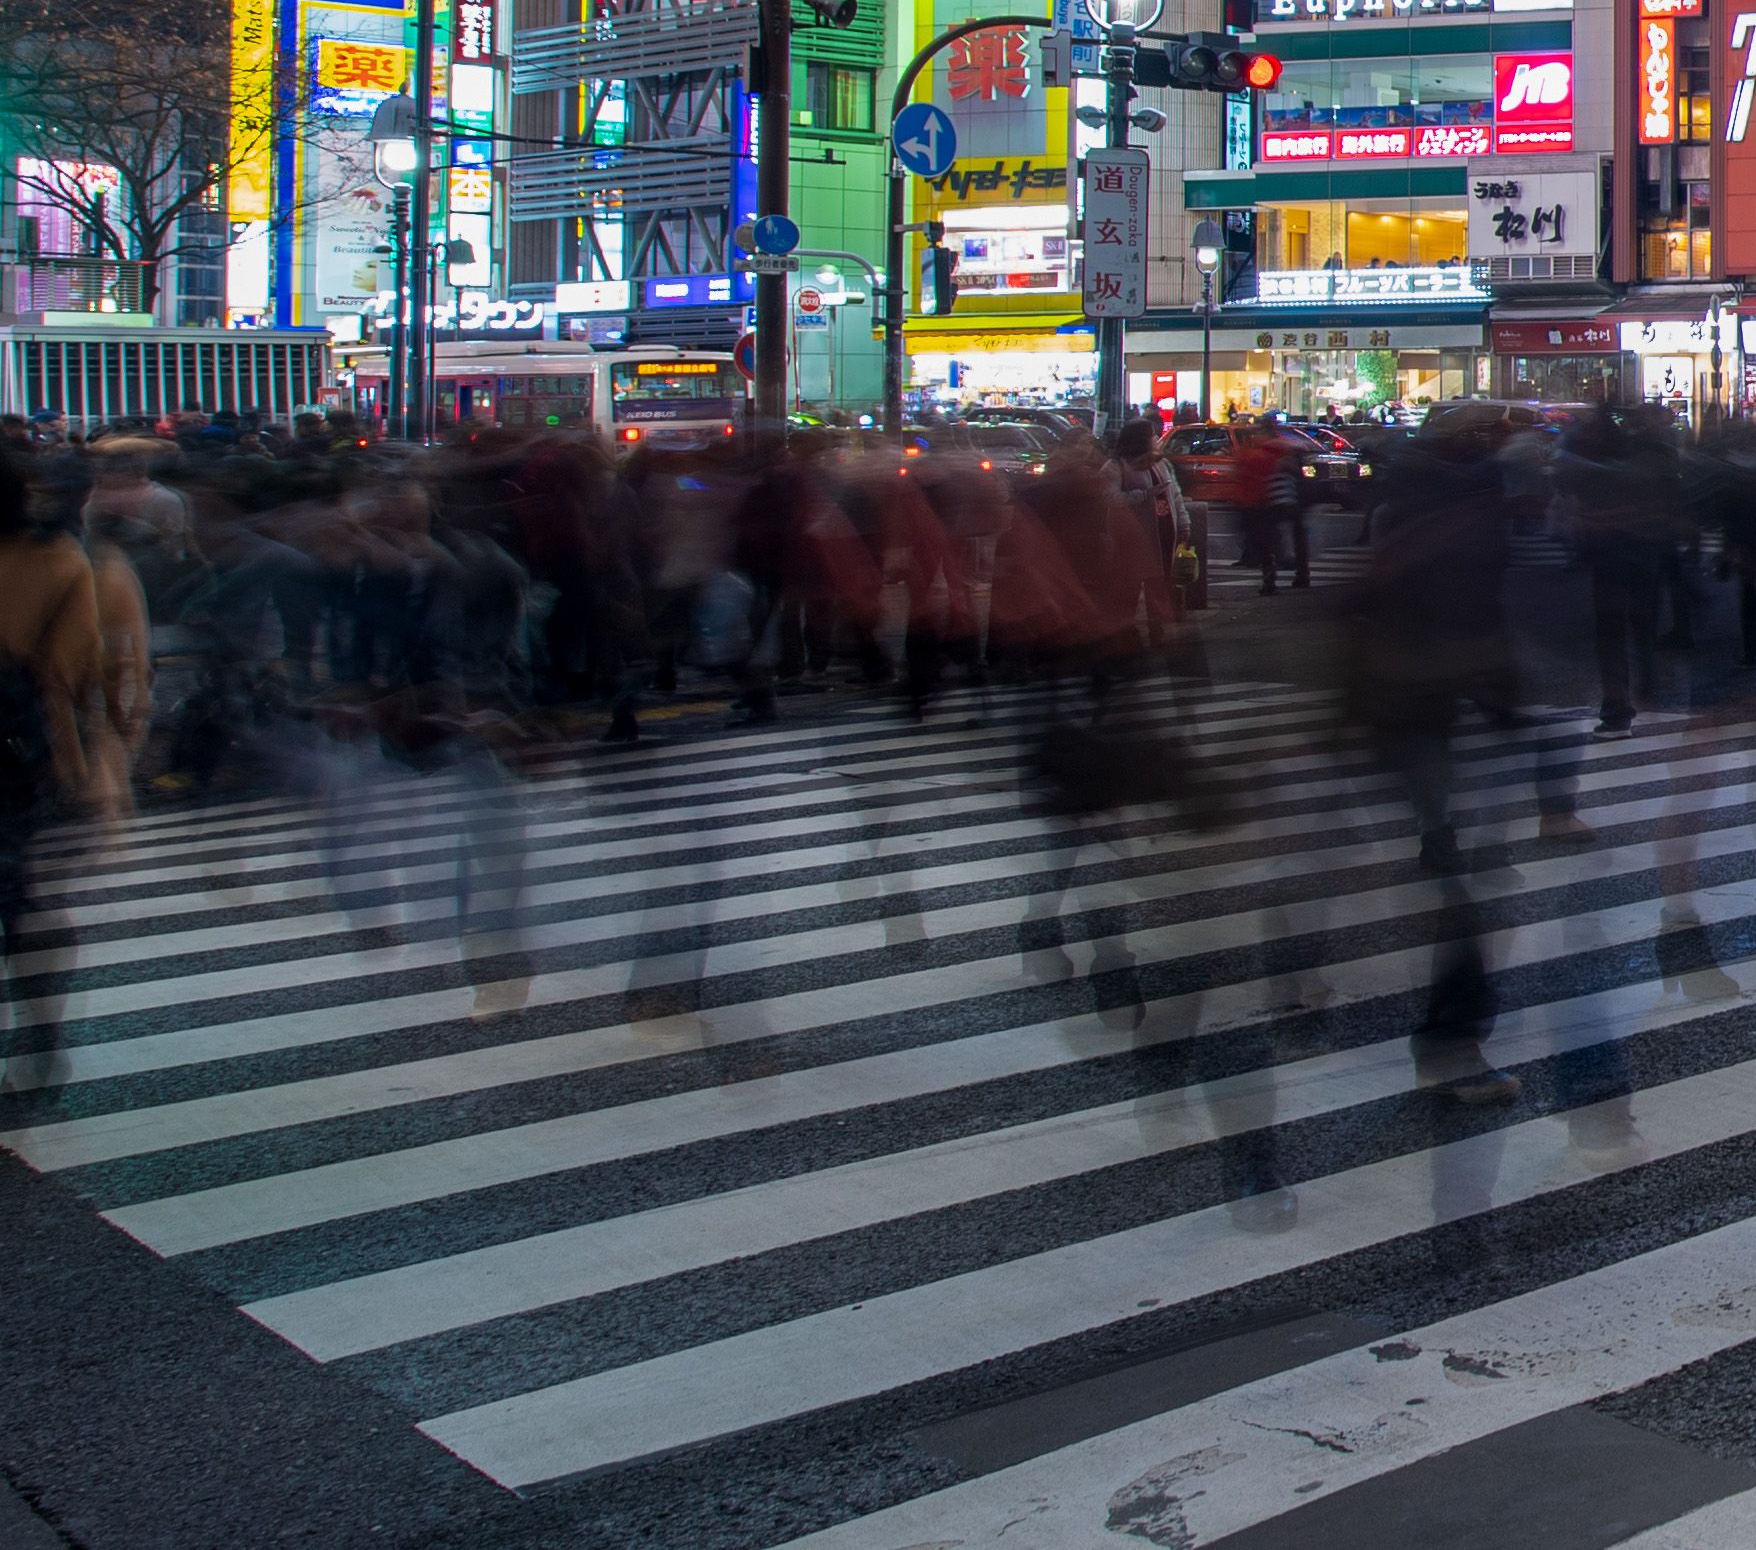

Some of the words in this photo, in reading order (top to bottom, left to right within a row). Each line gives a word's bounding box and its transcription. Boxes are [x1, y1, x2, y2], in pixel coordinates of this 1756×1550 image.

[334, 46, 395, 89] 薬
[1501, 62, 1571, 111] JTB
[1126, 166, 1143, 247] Dougen-zaka
[1473, 181, 1519, 199] うなぎ
[1093, 166, 1125, 300] 道玄坂
[754, 258, 798, 269] 歩行者優先
[374, 289, 544, 331] グメタウン
[653, 410, 677, 419] BUS
